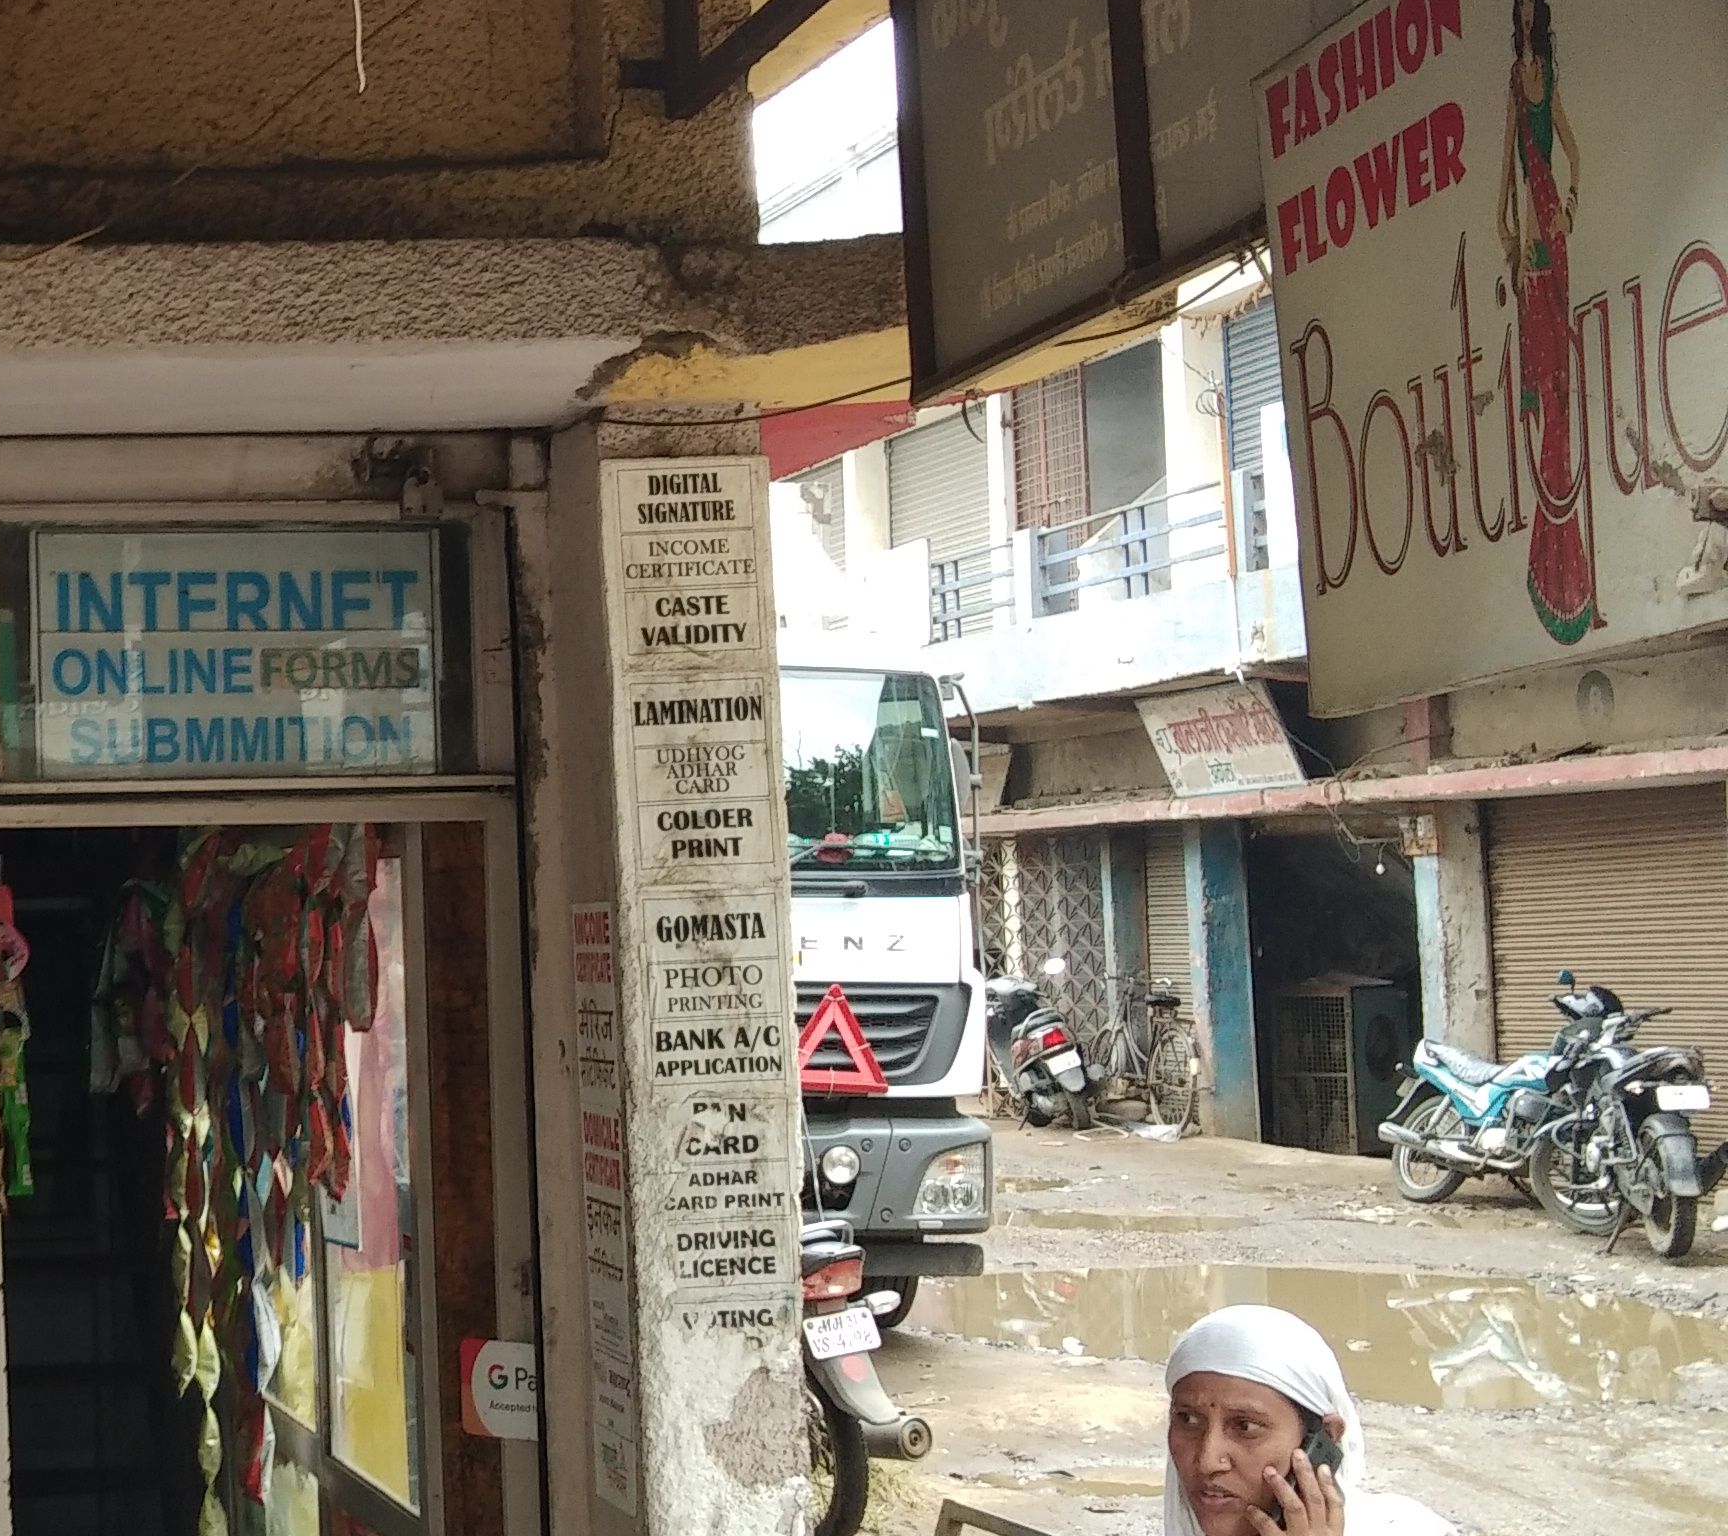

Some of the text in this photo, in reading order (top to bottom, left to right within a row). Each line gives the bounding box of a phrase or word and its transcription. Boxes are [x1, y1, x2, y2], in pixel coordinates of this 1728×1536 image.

[1276, 100, 1467, 277] FLOWER
[1290, 230, 1728, 630] Boutique
[647, 472, 723, 496] DIGITAL
[636, 499, 736, 525] SIGNATURE
[648, 538, 731, 558] INCOME
[625, 557, 757, 581] CERTIFICATE
[654, 594, 731, 618] CASTE
[640, 622, 748, 648] VALIDITY
[51, 646, 421, 697] ONLINE FORMS
[633, 694, 763, 727] LAMINATION
[69, 714, 414, 765] SUBMMITION
[656, 745, 746, 764] UDHYOG
[664, 762, 739, 780] ADHAR
[674, 777, 731, 796] CARD
[656, 807, 754, 833] COLOER
[671, 836, 743, 860] PRINT
[655, 911, 767, 943] GOMASTA
[663, 963, 764, 990] PHOTO
[666, 992, 763, 1014] PRINTING
[654, 1024, 781, 1054] BANK A/C
[654, 1054, 783, 1079] APPLICATION
[692, 1102, 747, 1124] PN
[688, 1169, 760, 1188] ADHAR
[723, 1191, 786, 1210] PRINT
[676, 1229, 777, 1253] DRIVING
[678, 1255, 778, 1280] LICENCE
